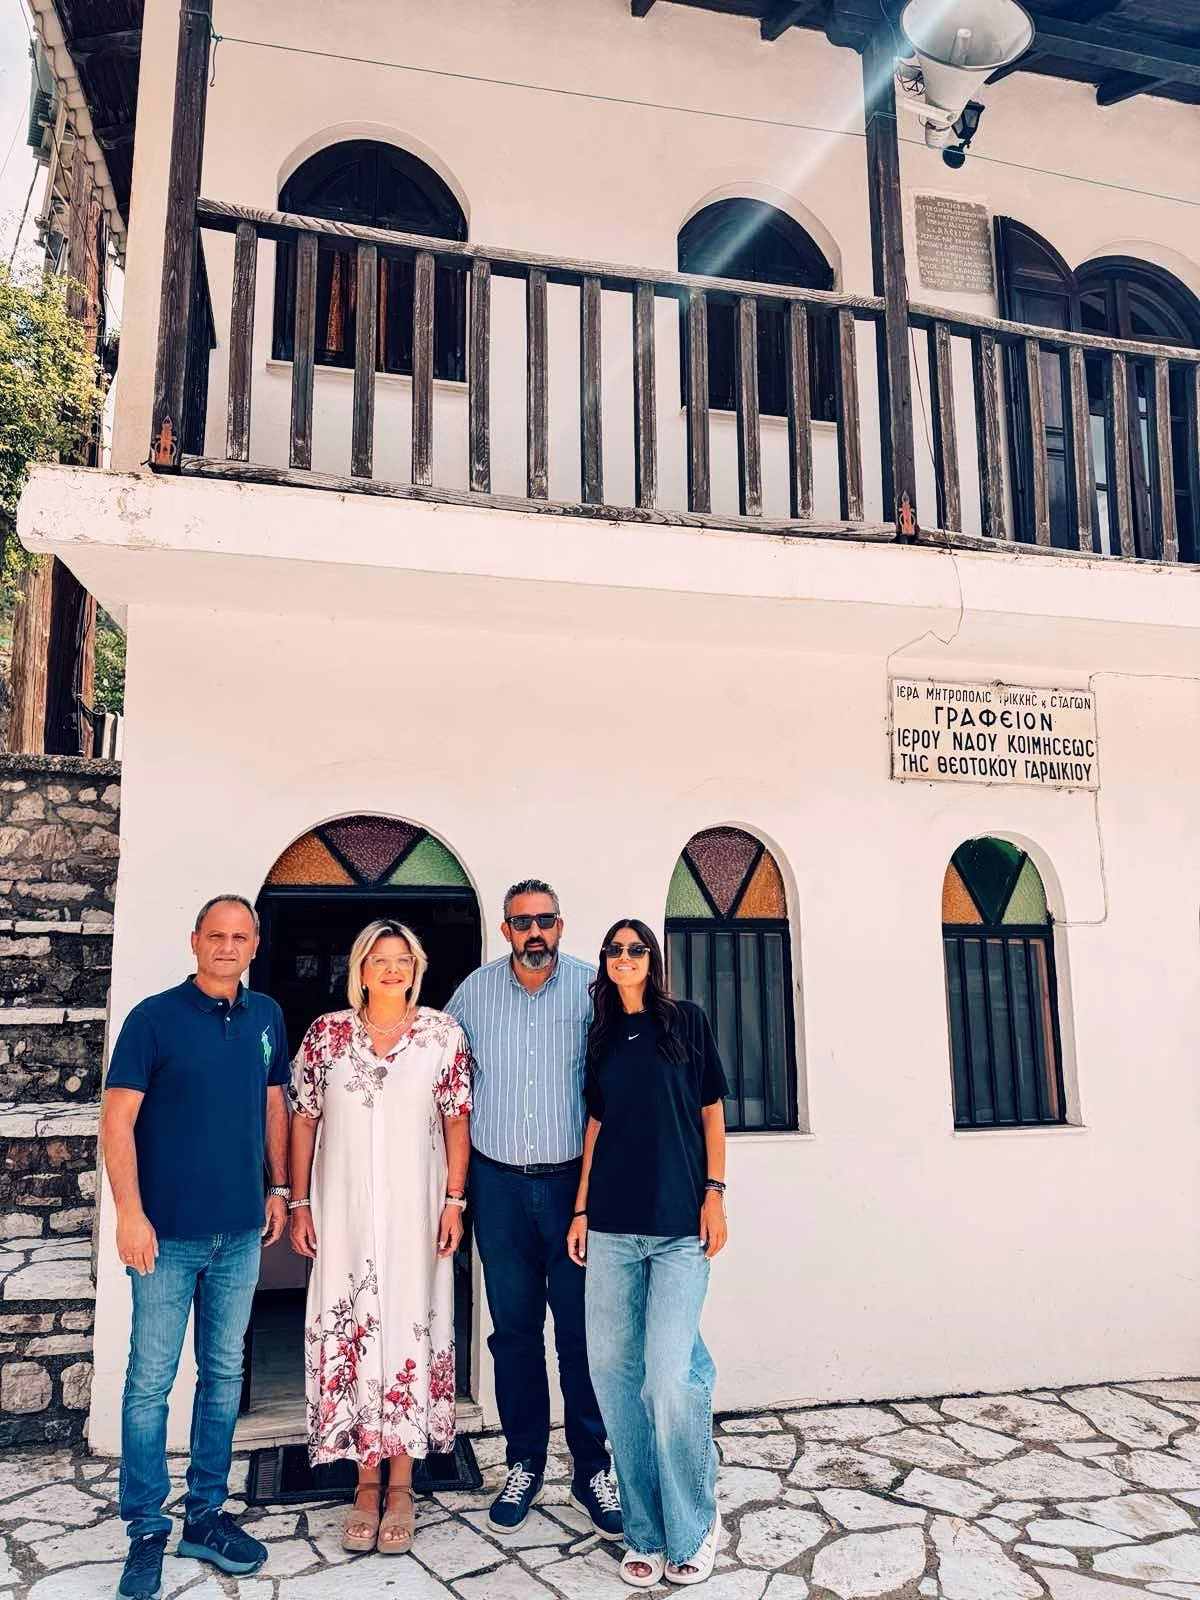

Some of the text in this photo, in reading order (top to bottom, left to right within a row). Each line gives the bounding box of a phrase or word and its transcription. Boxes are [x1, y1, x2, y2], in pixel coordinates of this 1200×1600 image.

[896, 685, 919, 701] ΙΕΡΑ
[935, 706, 1053, 732] ΓΡΑΦΕΙΟΝ
[897, 727, 940, 752] ΙΕΡΟΥ
[952, 731, 998, 752] ΝΑΟΥ
[937, 756, 1017, 777] ΘΕΟΤΟΚΟΥ
[1024, 759, 1092, 782] ΓΑΡΔΙΚΙΟΥ
